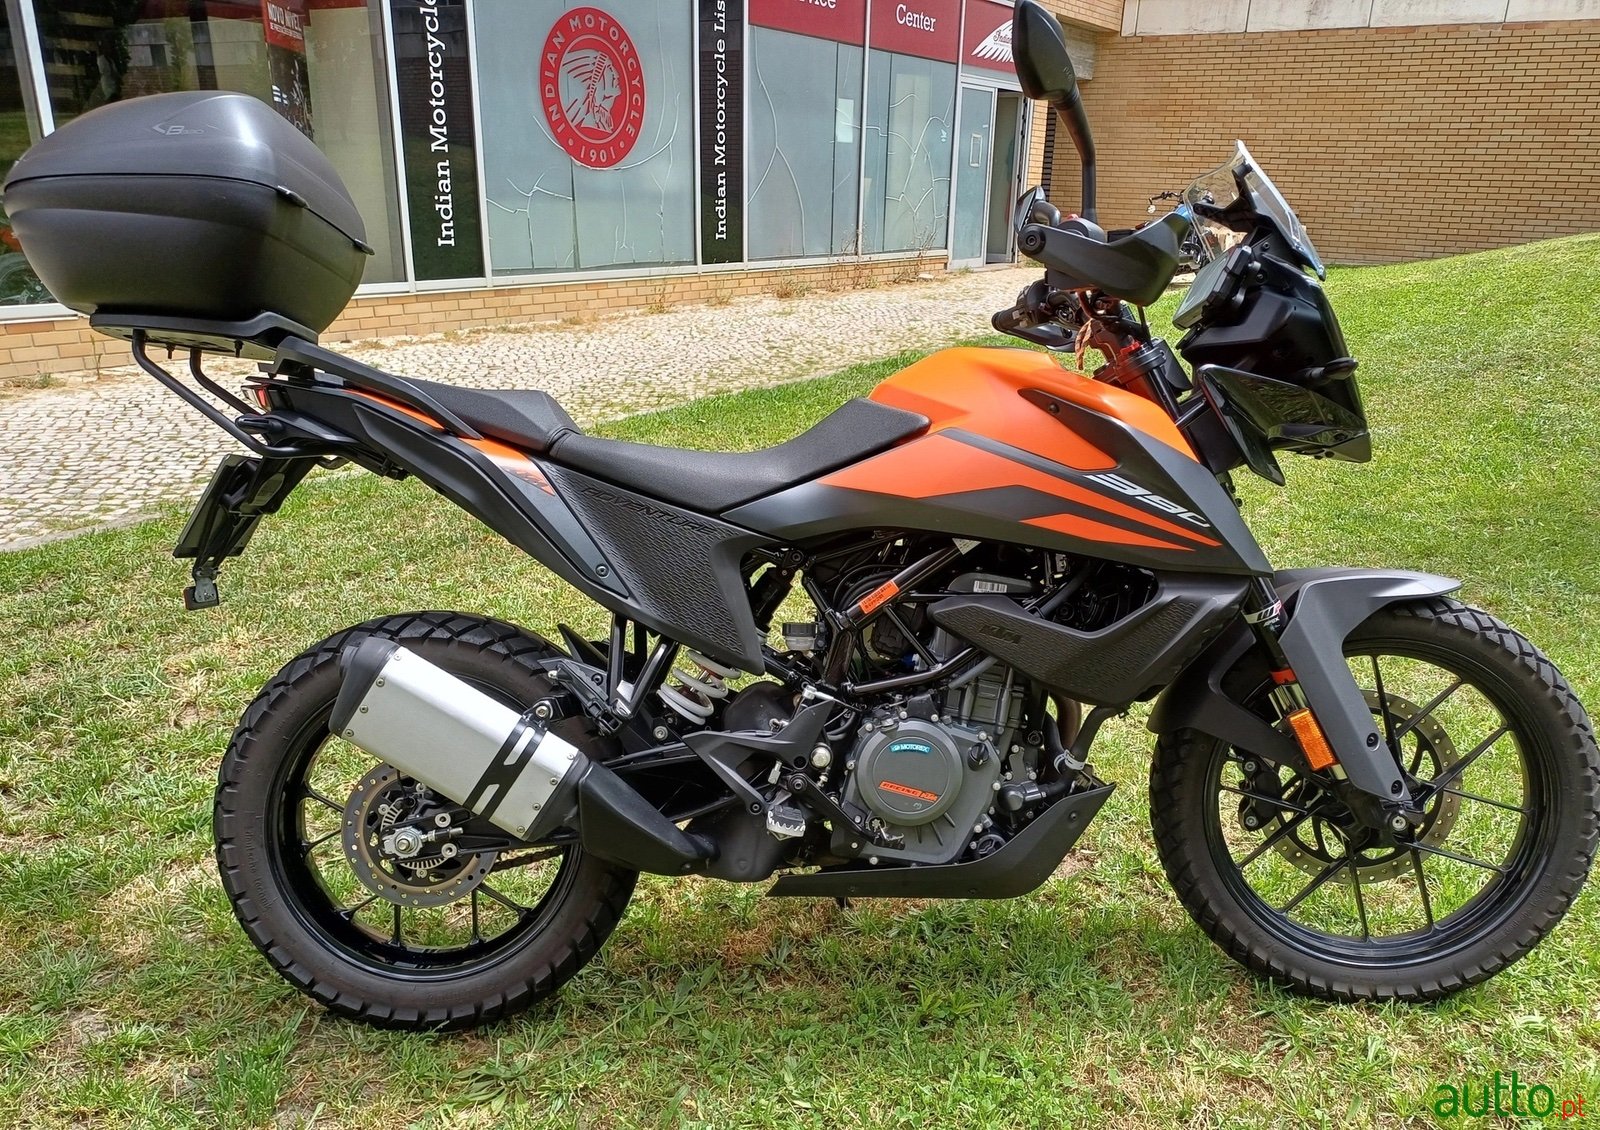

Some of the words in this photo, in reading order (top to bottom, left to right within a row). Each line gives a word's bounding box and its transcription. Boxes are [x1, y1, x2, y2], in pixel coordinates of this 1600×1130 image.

[895, 4, 936, 32] Center
[545, 31, 566, 134] INDIAN
[569, 13, 641, 138] MOTORCYCLE
[714, 39, 728, 165] Motorcycle
[580, 146, 616, 162] 1901
[434, 159, 455, 247] Indian
[715, 171, 727, 240] Indian
[1083, 473, 1211, 528] 390
[901, 743, 931, 753] MOTOREX
